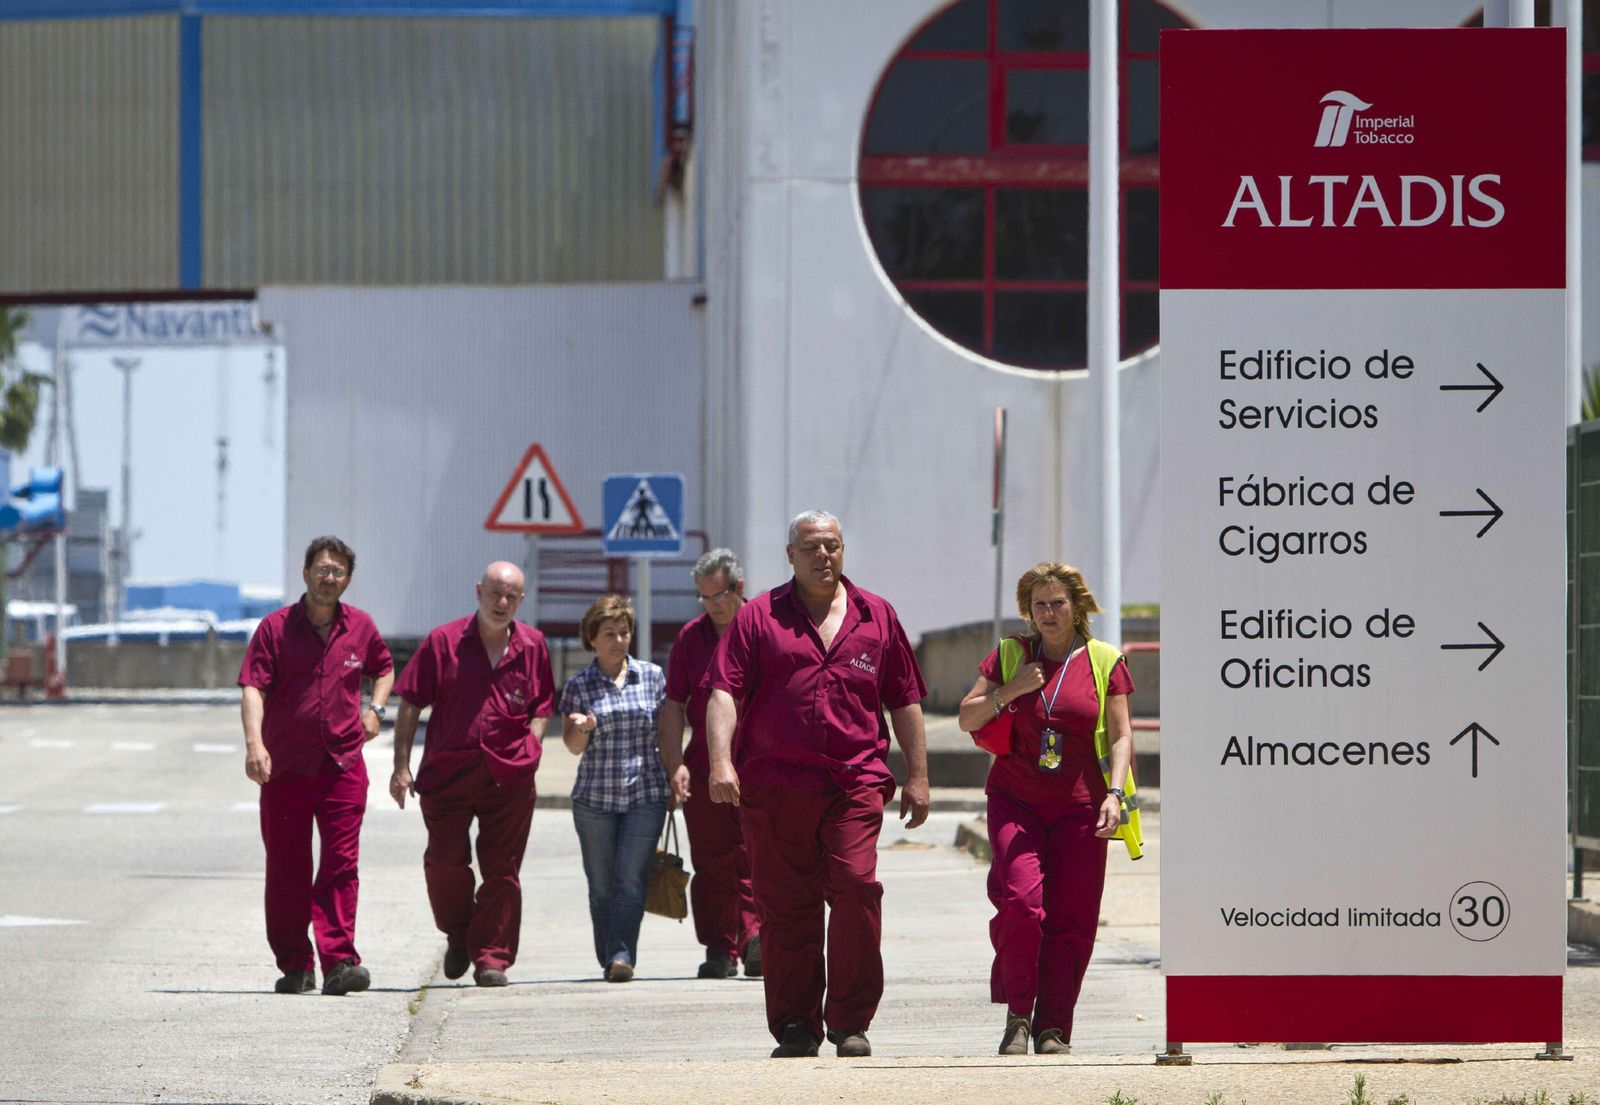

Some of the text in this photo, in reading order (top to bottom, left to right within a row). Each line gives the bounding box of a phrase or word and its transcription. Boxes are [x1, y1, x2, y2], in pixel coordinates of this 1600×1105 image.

[1353, 131, 1415, 144] Tobacco
[1355, 114, 1415, 131] Imperial
[1221, 173, 1505, 228] ALTADIS
[125, 301, 259, 338] Navanti
[1219, 349, 1415, 381] Edificio de
[1218, 398, 1379, 430] Servicios
[1219, 473, 1416, 507] Fábrica de
[1218, 525, 1368, 564] Cigarros
[1220, 607, 1416, 640] Edificio de
[1220, 657, 1371, 689] Oficinas
[1220, 735, 1431, 767] Almacenes
[1220, 894, 1505, 928] Velocidad limitada 30
